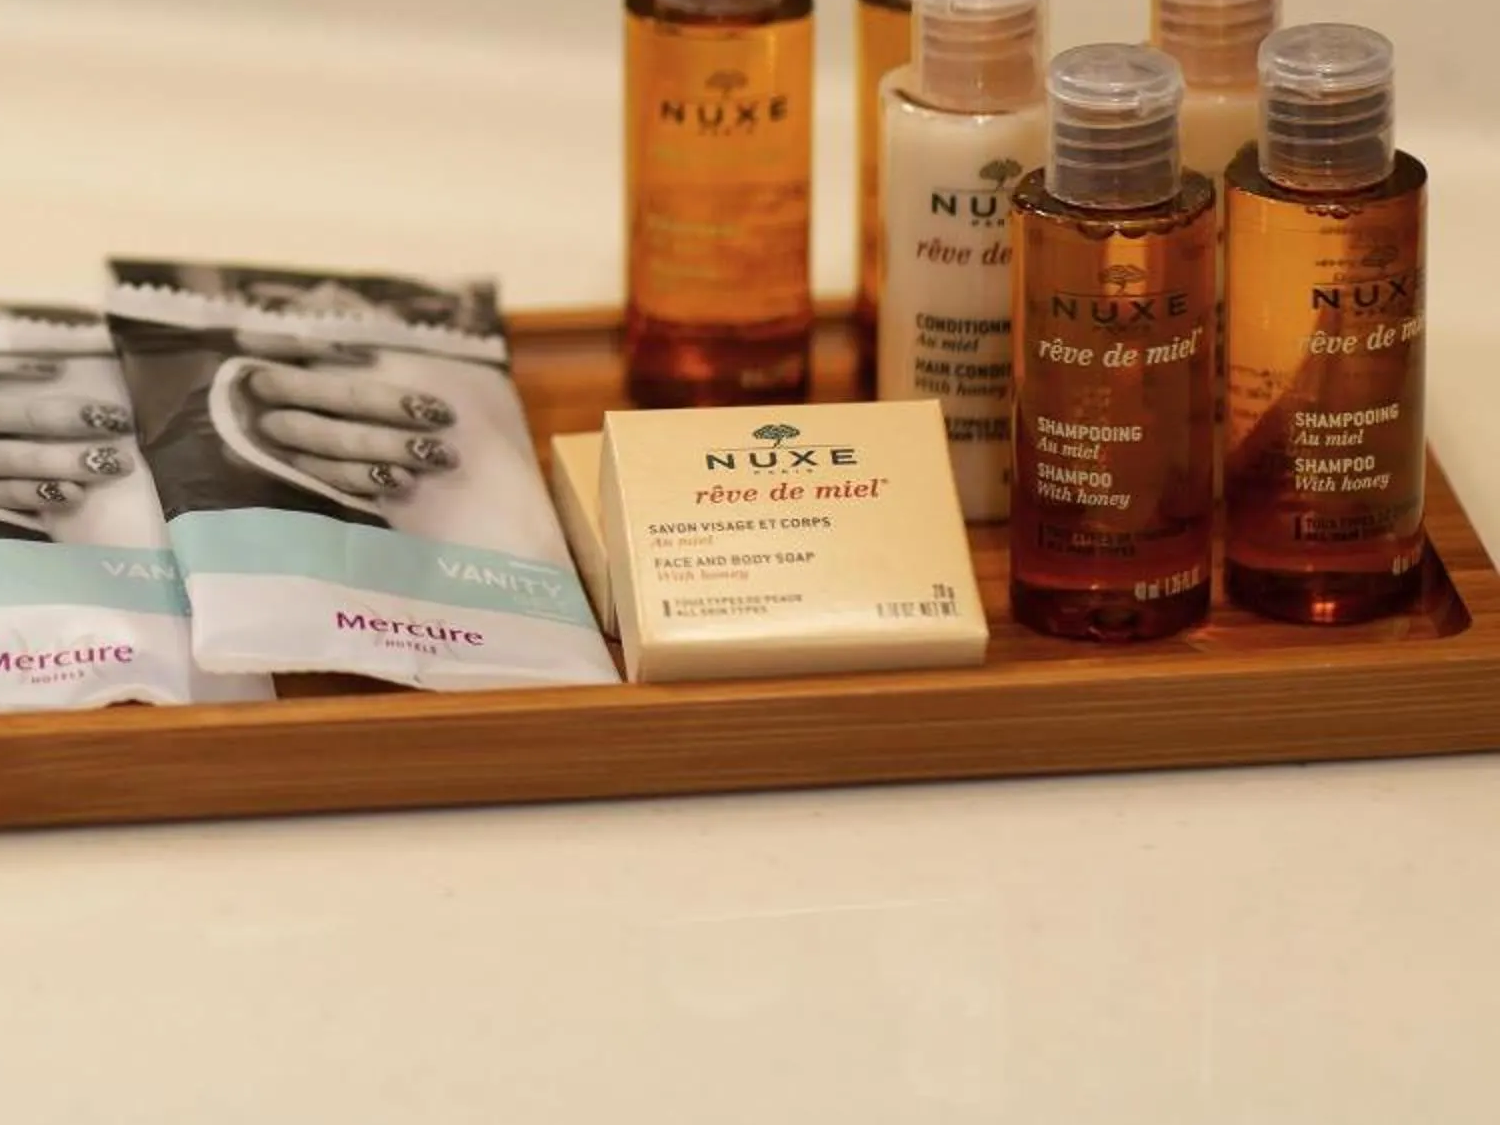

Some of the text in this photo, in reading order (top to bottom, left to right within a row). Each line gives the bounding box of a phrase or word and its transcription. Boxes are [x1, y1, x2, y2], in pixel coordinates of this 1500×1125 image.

[660, 95, 789, 126] NUXE
[931, 192, 998, 218] NU
[915, 237, 973, 266] rêve
[1052, 293, 1189, 325] NUXE
[915, 312, 1012, 335] CONDITIONN
[1367, 324, 1397, 350] de
[1038, 338, 1094, 367] rêve
[1102, 342, 1139, 368] de
[1295, 403, 1400, 428] SHAMPOOING
[1037, 416, 1143, 442] SHAMPOOING
[1294, 429, 1365, 446] Au miel
[705, 448, 858, 470] NUXE
[1036, 436, 1101, 460] Au miel
[1037, 462, 1113, 488] SHAMPOO
[1295, 455, 1376, 474] SHAMPOO
[695, 478, 881, 505] rêve de miel
[1036, 479, 1132, 510] With honey
[1295, 472, 1392, 492] With honey
[649, 516, 832, 535] SAVON VISAGE ET CORPS
[101, 560, 176, 581] VAN
[654, 551, 815, 569] FACE AND BODY SOAP
[438, 556, 563, 598] VANITY
[336, 611, 484, 646] Mercure
